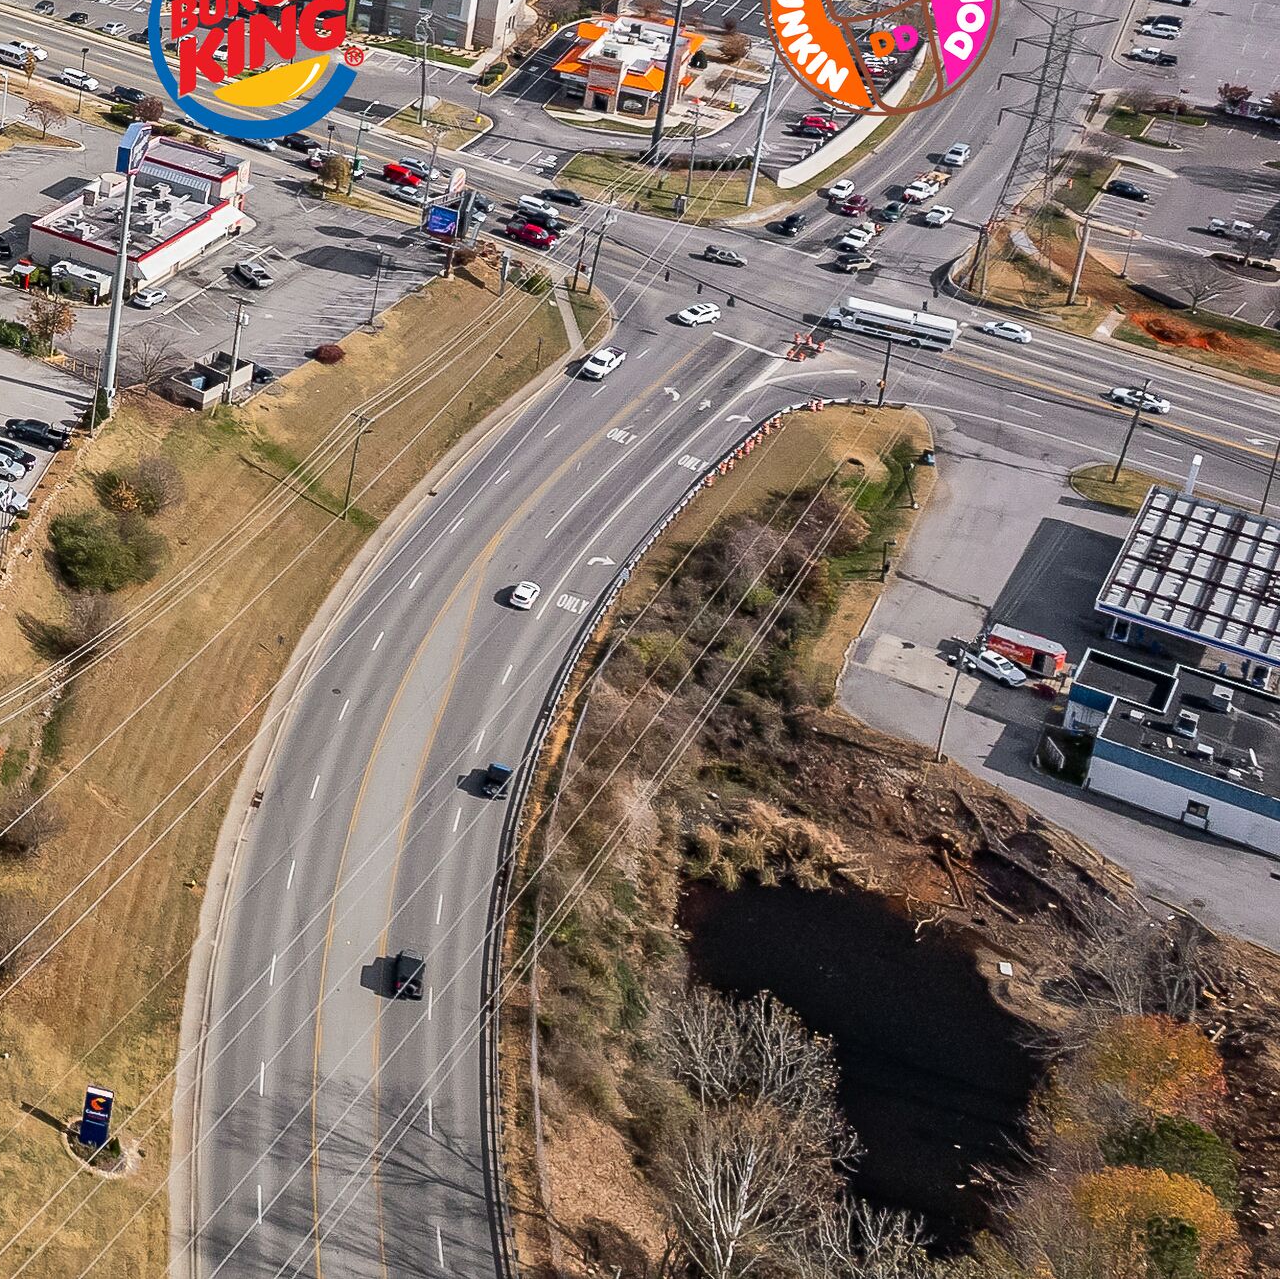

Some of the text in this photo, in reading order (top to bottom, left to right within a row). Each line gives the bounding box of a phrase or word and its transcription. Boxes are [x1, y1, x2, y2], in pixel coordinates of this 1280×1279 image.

[606, 427, 638, 445] ONLY
[677, 454, 710, 472] ONLY
[557, 593, 590, 615] ONLY
